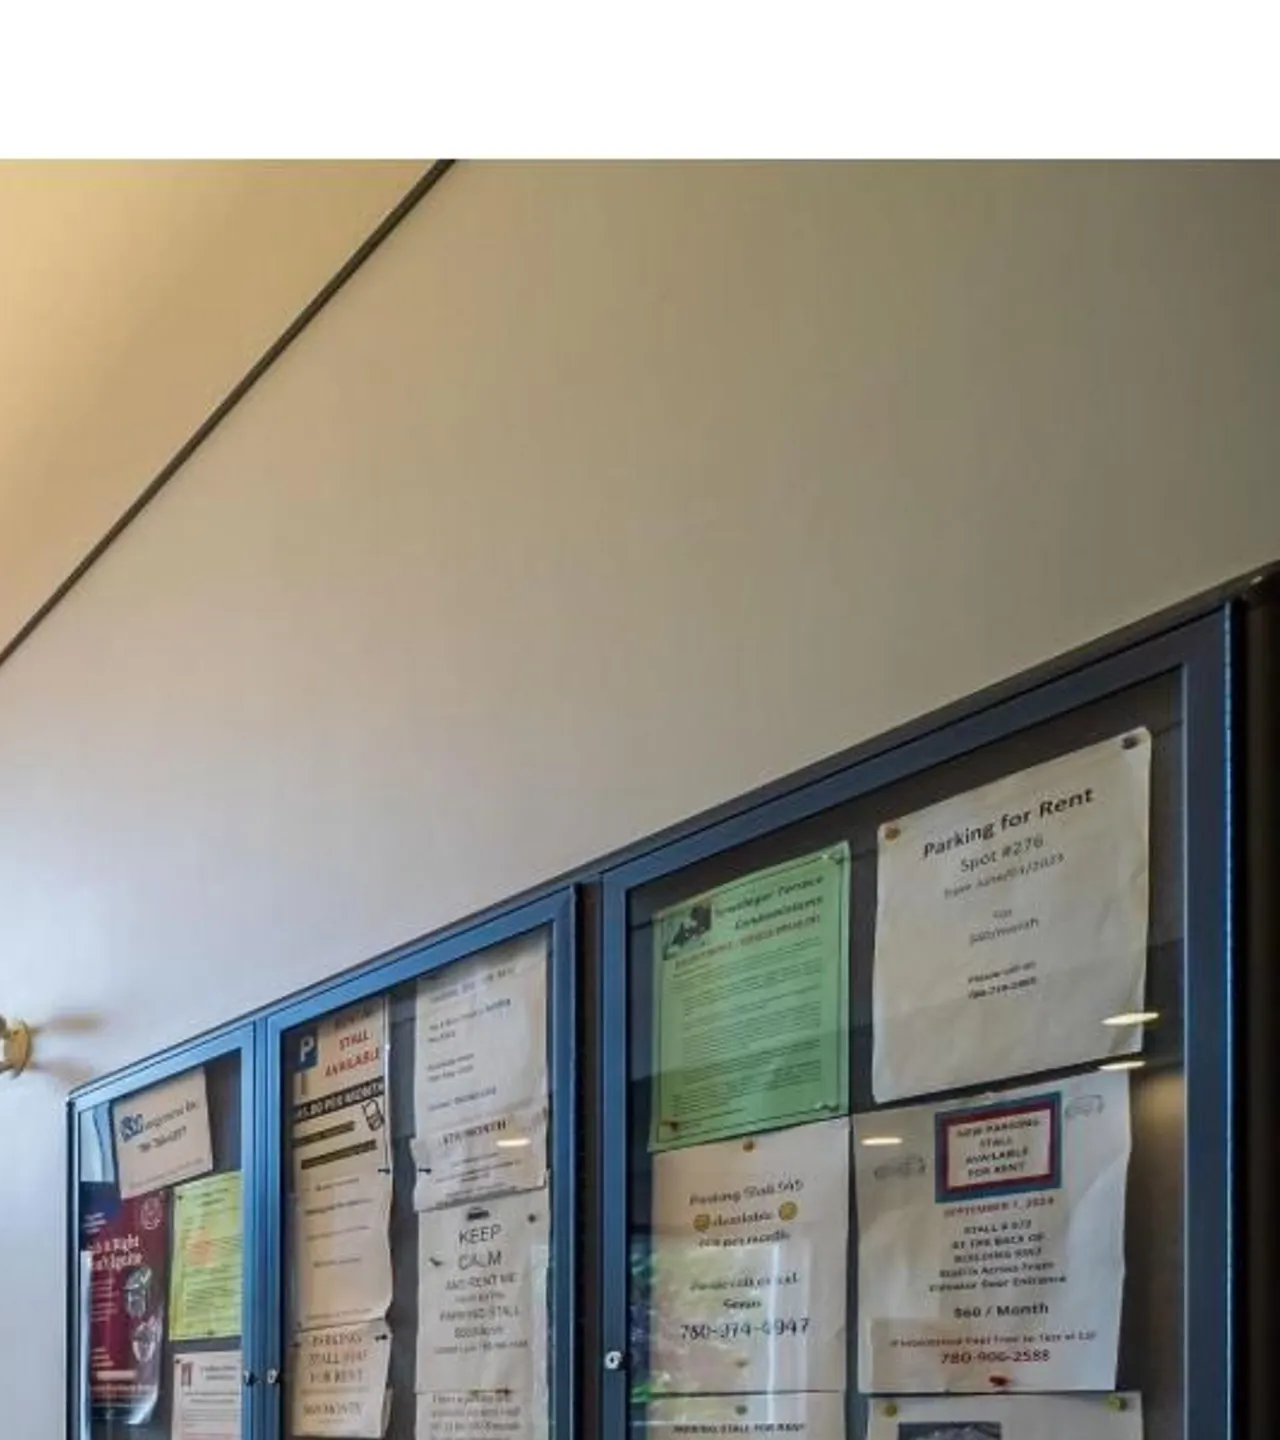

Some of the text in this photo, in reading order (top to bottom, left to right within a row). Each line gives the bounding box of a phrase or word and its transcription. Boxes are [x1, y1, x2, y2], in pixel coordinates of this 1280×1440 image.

[922, 788, 1095, 858] Parking for Rent
[961, 851, 997, 872] Spot
[300, 1036, 315, 1063] P
[457, 1223, 502, 1245] KEEP
[458, 1250, 502, 1270] CALM
[953, 1306, 981, 1319] $60
[996, 1301, 1049, 1317] Month
